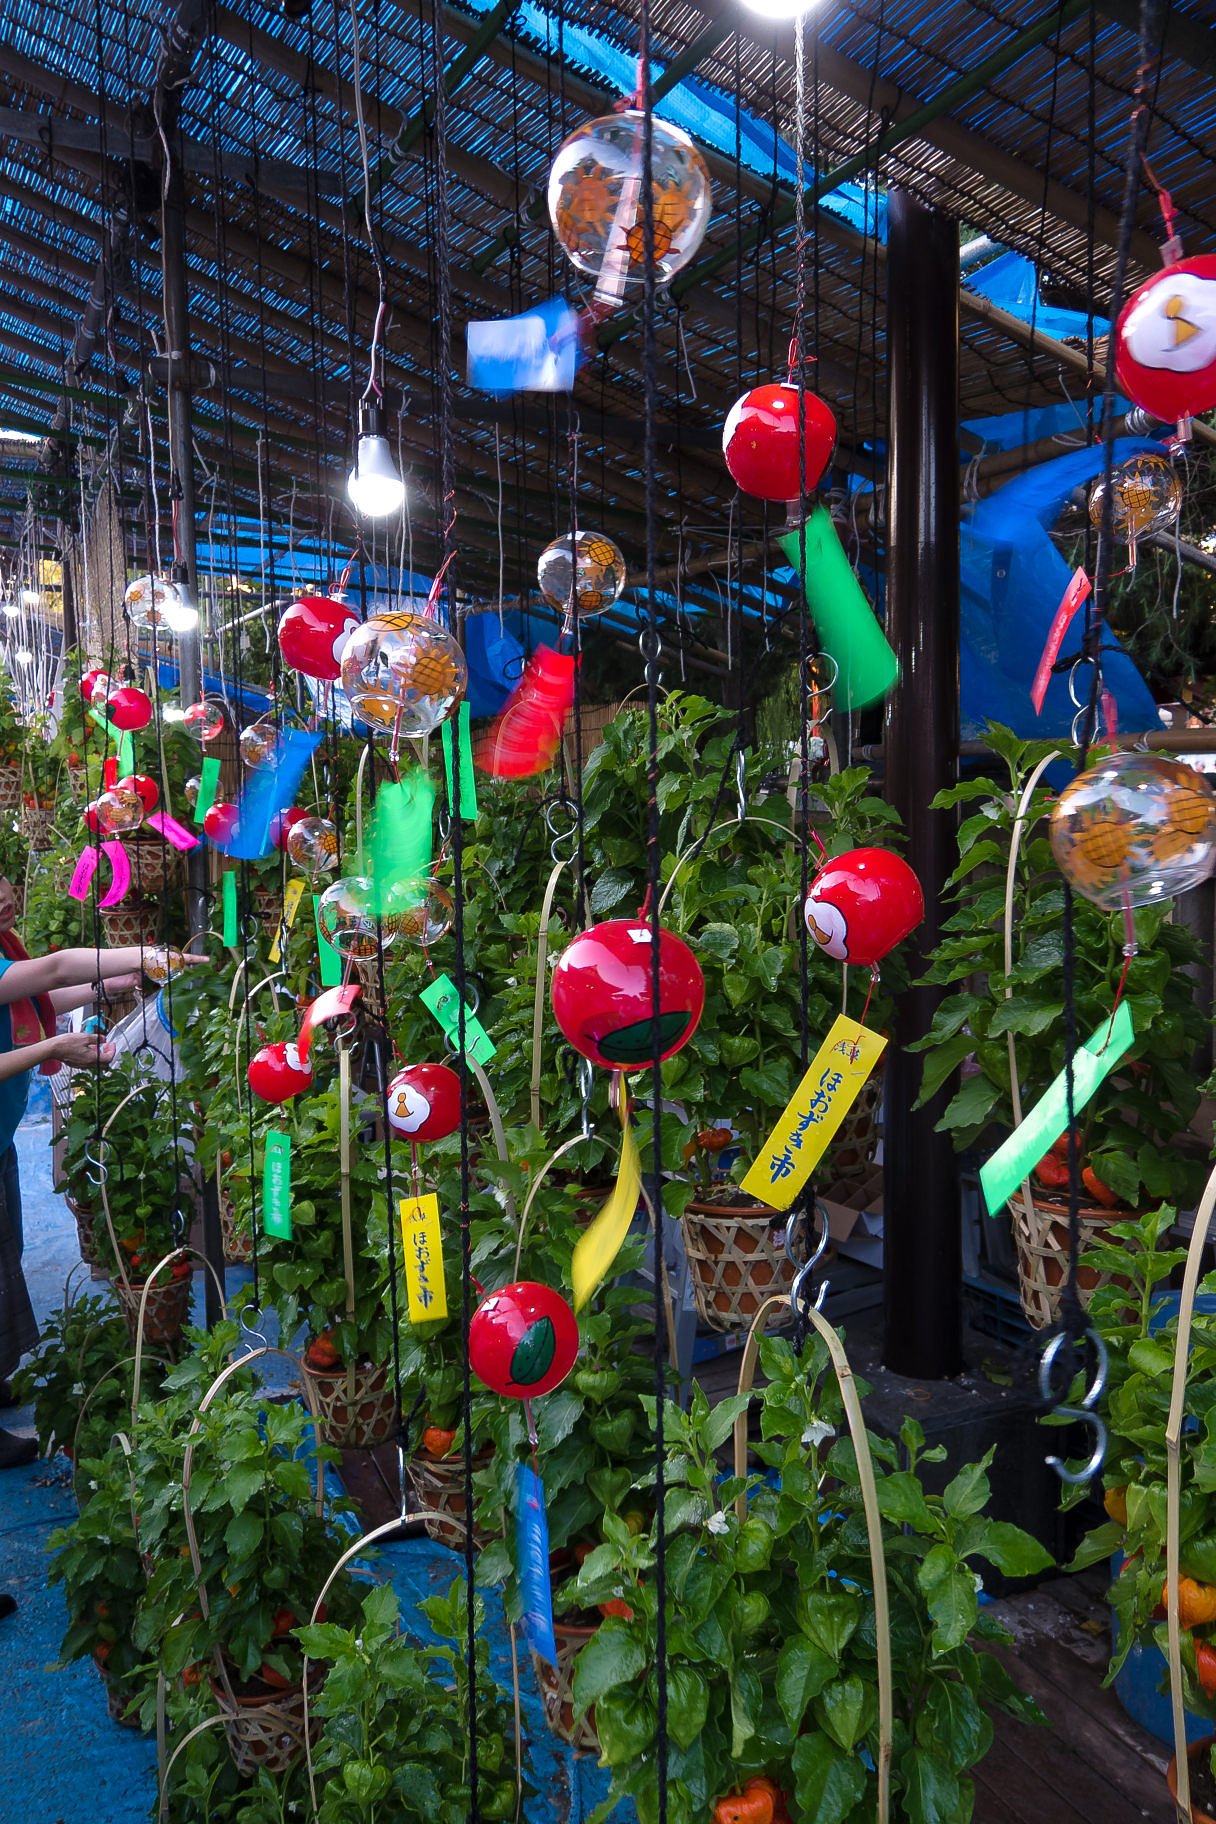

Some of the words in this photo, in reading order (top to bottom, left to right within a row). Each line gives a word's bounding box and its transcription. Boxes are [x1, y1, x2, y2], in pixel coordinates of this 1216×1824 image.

[770, 1068, 844, 1183] ほおずき市
